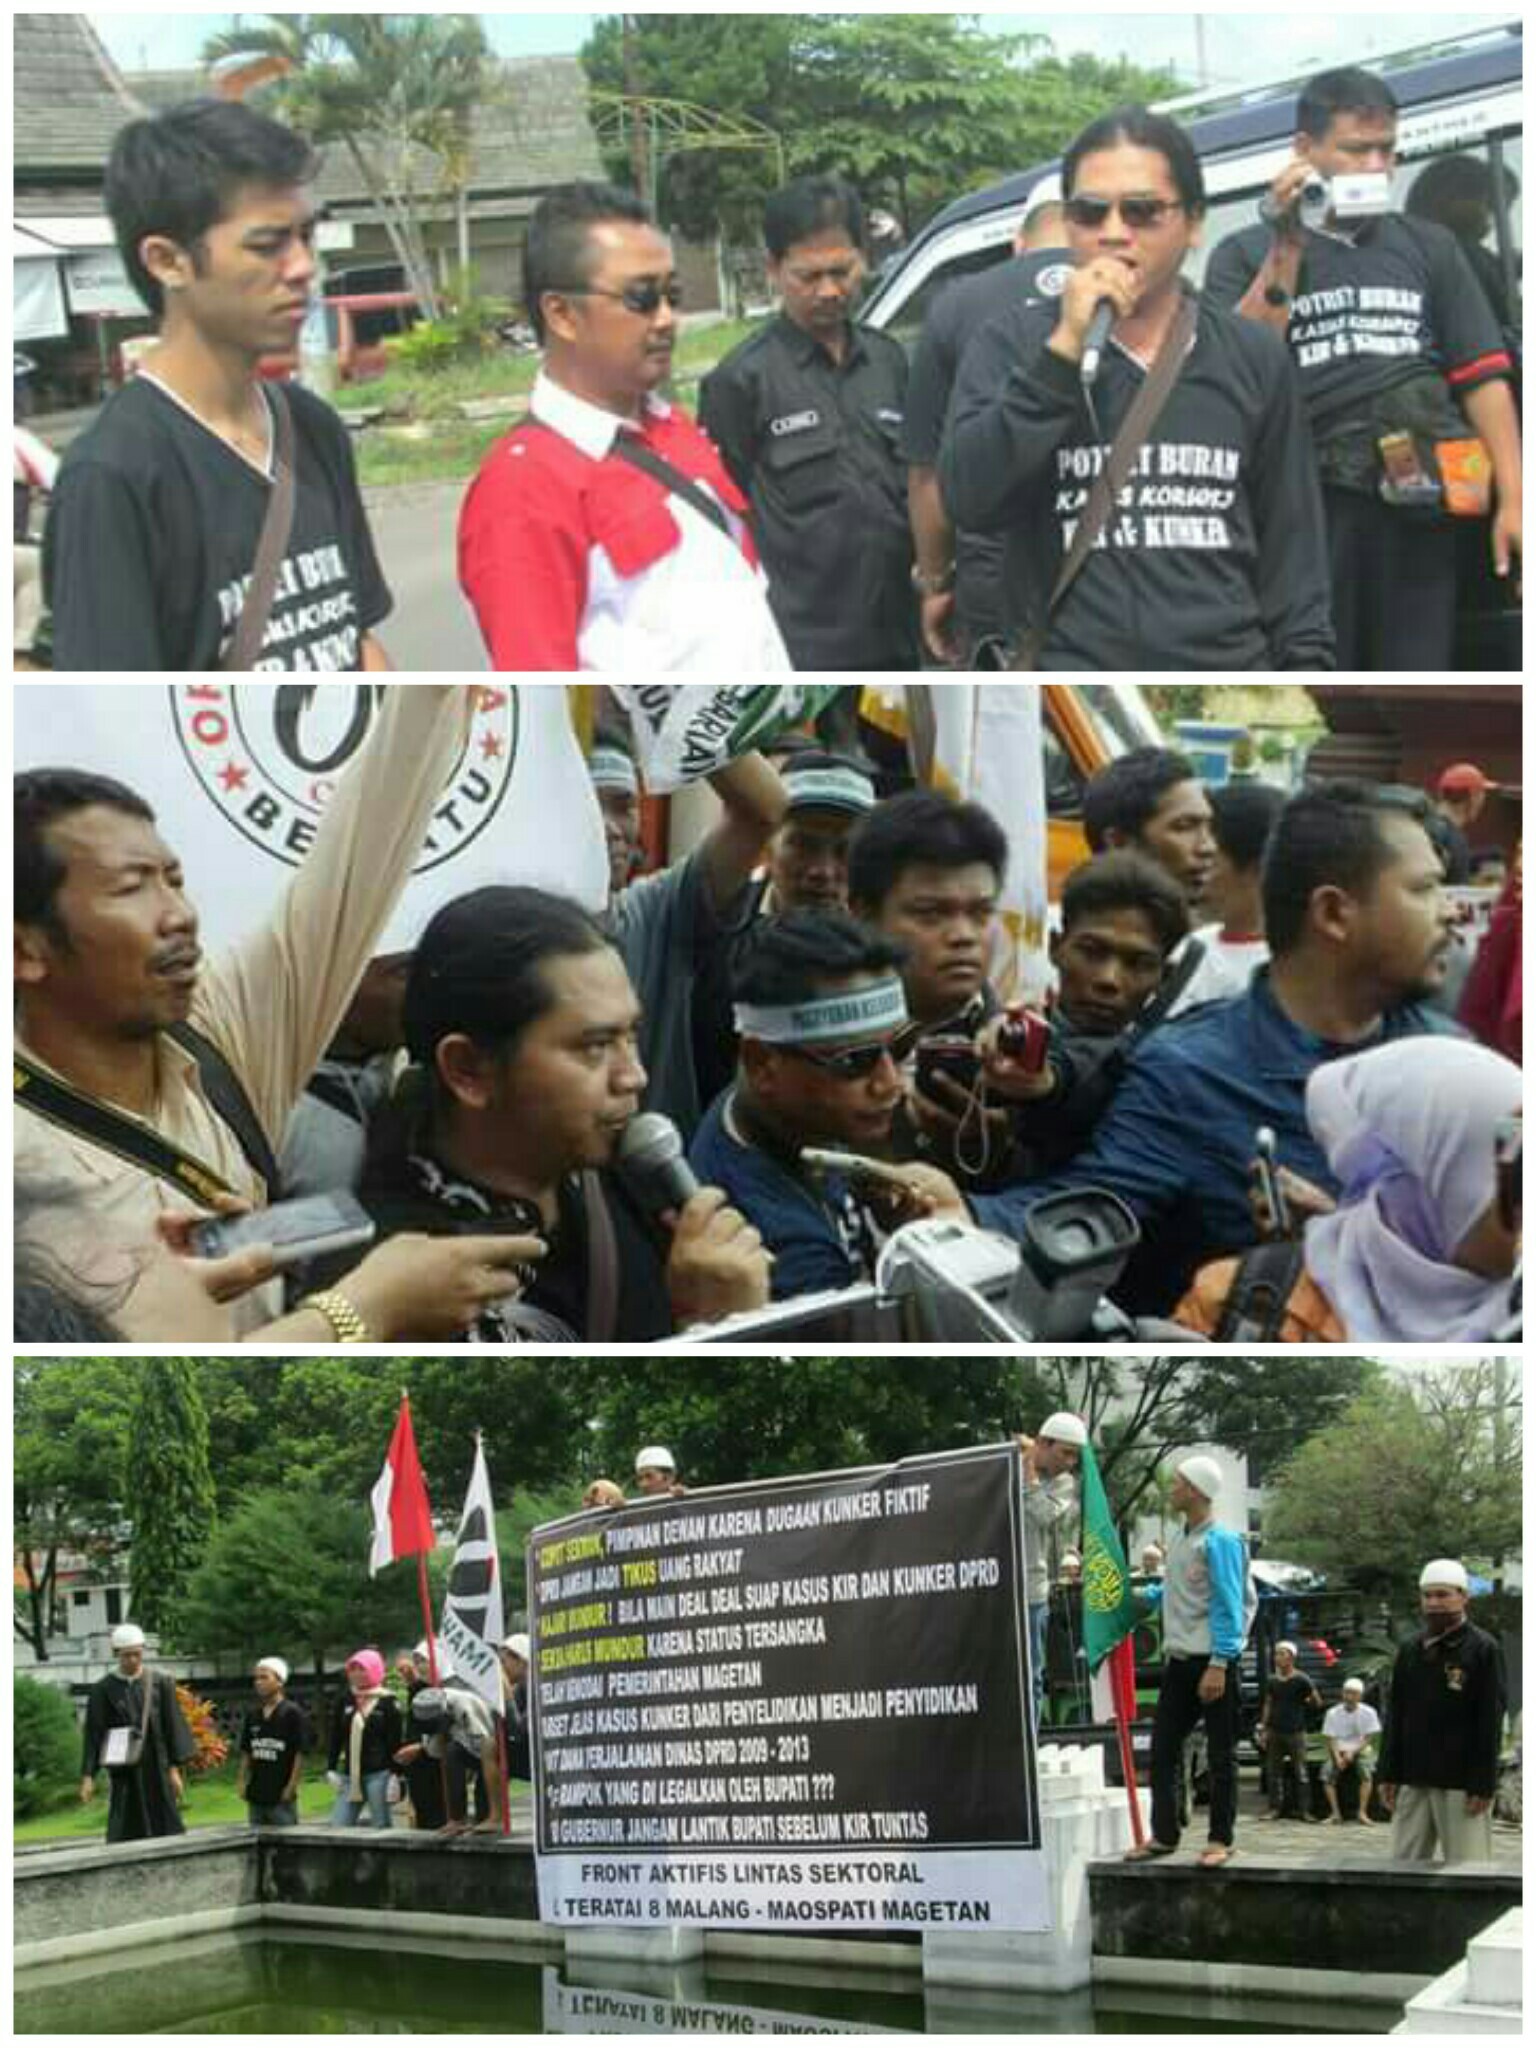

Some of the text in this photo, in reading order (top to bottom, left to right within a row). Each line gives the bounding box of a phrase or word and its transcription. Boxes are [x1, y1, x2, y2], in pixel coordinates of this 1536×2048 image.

[663, 1516, 705, 1544] DEWAN
[707, 1509, 762, 1539] KARENA
[766, 1501, 819, 1532] DUGAAN
[823, 1490, 881, 1523] KUNKER
[885, 1484, 931, 1515] FIKTIF
[622, 1560, 657, 1588] TIKUS
[659, 1555, 691, 1582] UANG
[694, 1548, 744, 1579] RAKYAT
[618, 1599, 644, 1625] BILA
[678, 1591, 709, 1617] DEAL
[711, 1587, 743, 1614] DEAL
[745, 1582, 779, 1610] SUAP
[782, 1576, 828, 1607] KASUS
[832, 1573, 858, 1602] KIR
[861, 1569, 889, 1599] DAN
[893, 1561, 956, 1596] KUNKER
[959, 1558, 999, 1589] DPRD
[647, 1629, 694, 1658] KARENA
[696, 1625, 742, 1652] STATUS
[745, 1616, 826, 1648] TERSANGKA
[608, 1667, 699, 1698] PEMERINTAHAN
[702, 1661, 762, 1691] MAGETAN
[596, 1705, 638, 1733] KASUS
[640, 1702, 691, 1730] KUNKER
[693, 1699, 722, 1727] DARI
[723, 1694, 817, 1725] PENYELIDIKAN
[820, 1690, 882, 1721] MENJADI
[886, 1683, 978, 1717] PENYIDIKAN
[665, 1740, 702, 1767] DINAS
[704, 1738, 737, 1764] DPRD
[738, 1736, 768, 1763] 2009
[777, 1734, 809, 1762] 2013
[604, 1780, 638, 1806] YANG
[642, 1779, 657, 1804] DI
[659, 1777, 726, 1804] LEGALKAN
[728, 1775, 761, 1802] OLEH
[763, 1775, 809, 1802] BUPATI
[811, 1772, 835, 1801] ???
[560, 1818, 623, 1843] GUBERNUR
[628, 1817, 678, 1842] JANGAN
[681, 1816, 729, 1842] LANTIK
[732, 1815, 775, 1841] BUPATI
[777, 1814, 841, 1841] SEBELUM
[843, 1813, 871, 1840] KIR
[872, 1811, 929, 1840] TUNTAS
[581, 1862, 924, 1884] FRONT AKTIFIS LINTAS SEKTORAL
[564, 1898, 642, 1917] TERATAI
[649, 1899, 660, 1918] 8
[666, 1899, 750, 1919] MALANG
[768, 1900, 875, 1921] MAOSPATI
[882, 1901, 990, 1921] MAGETAN
